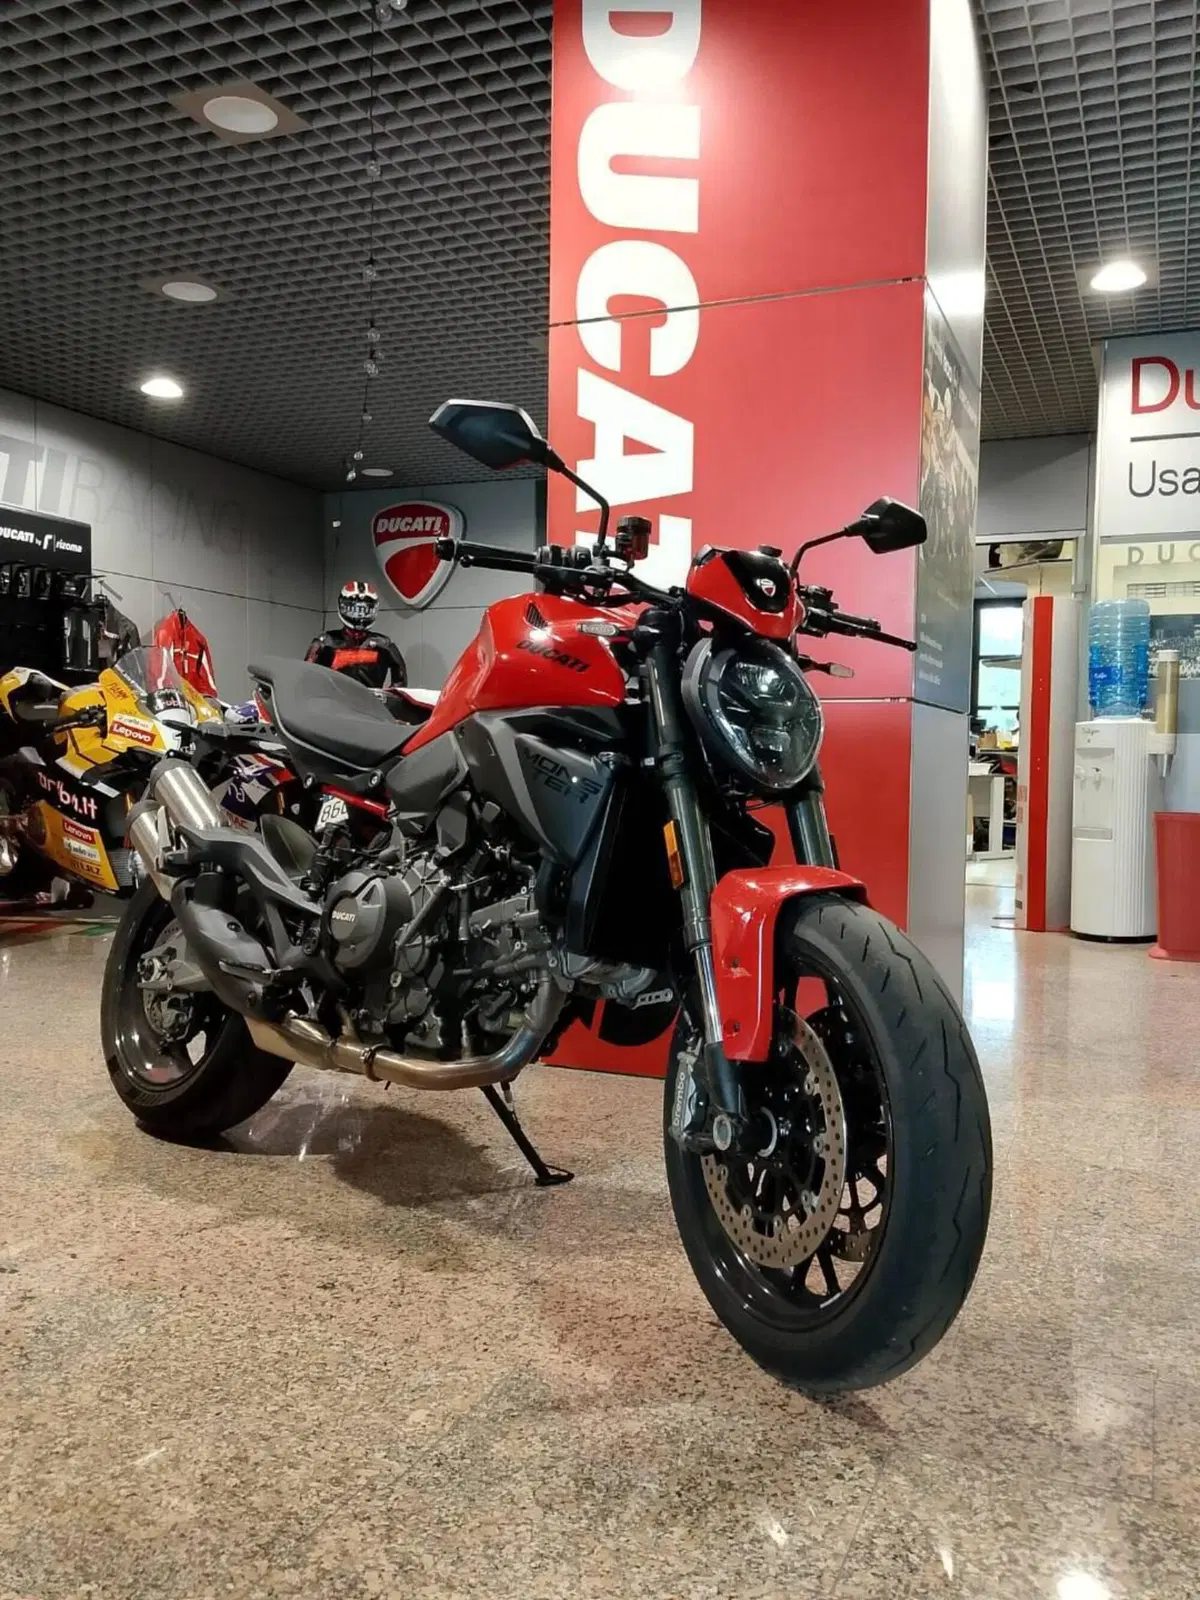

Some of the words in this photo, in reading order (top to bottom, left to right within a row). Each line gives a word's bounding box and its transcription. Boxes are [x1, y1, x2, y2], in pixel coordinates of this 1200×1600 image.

[1129, 460, 1200, 498] Usa
[376, 516, 443, 533] DUCATI
[56, 539, 83, 553] rizoma
[516, 640, 590, 673] DUCATI
[113, 723, 151, 742] Lenovo
[332, 910, 356, 922] DUCATI
[673, 1071, 686, 1127] brembo
